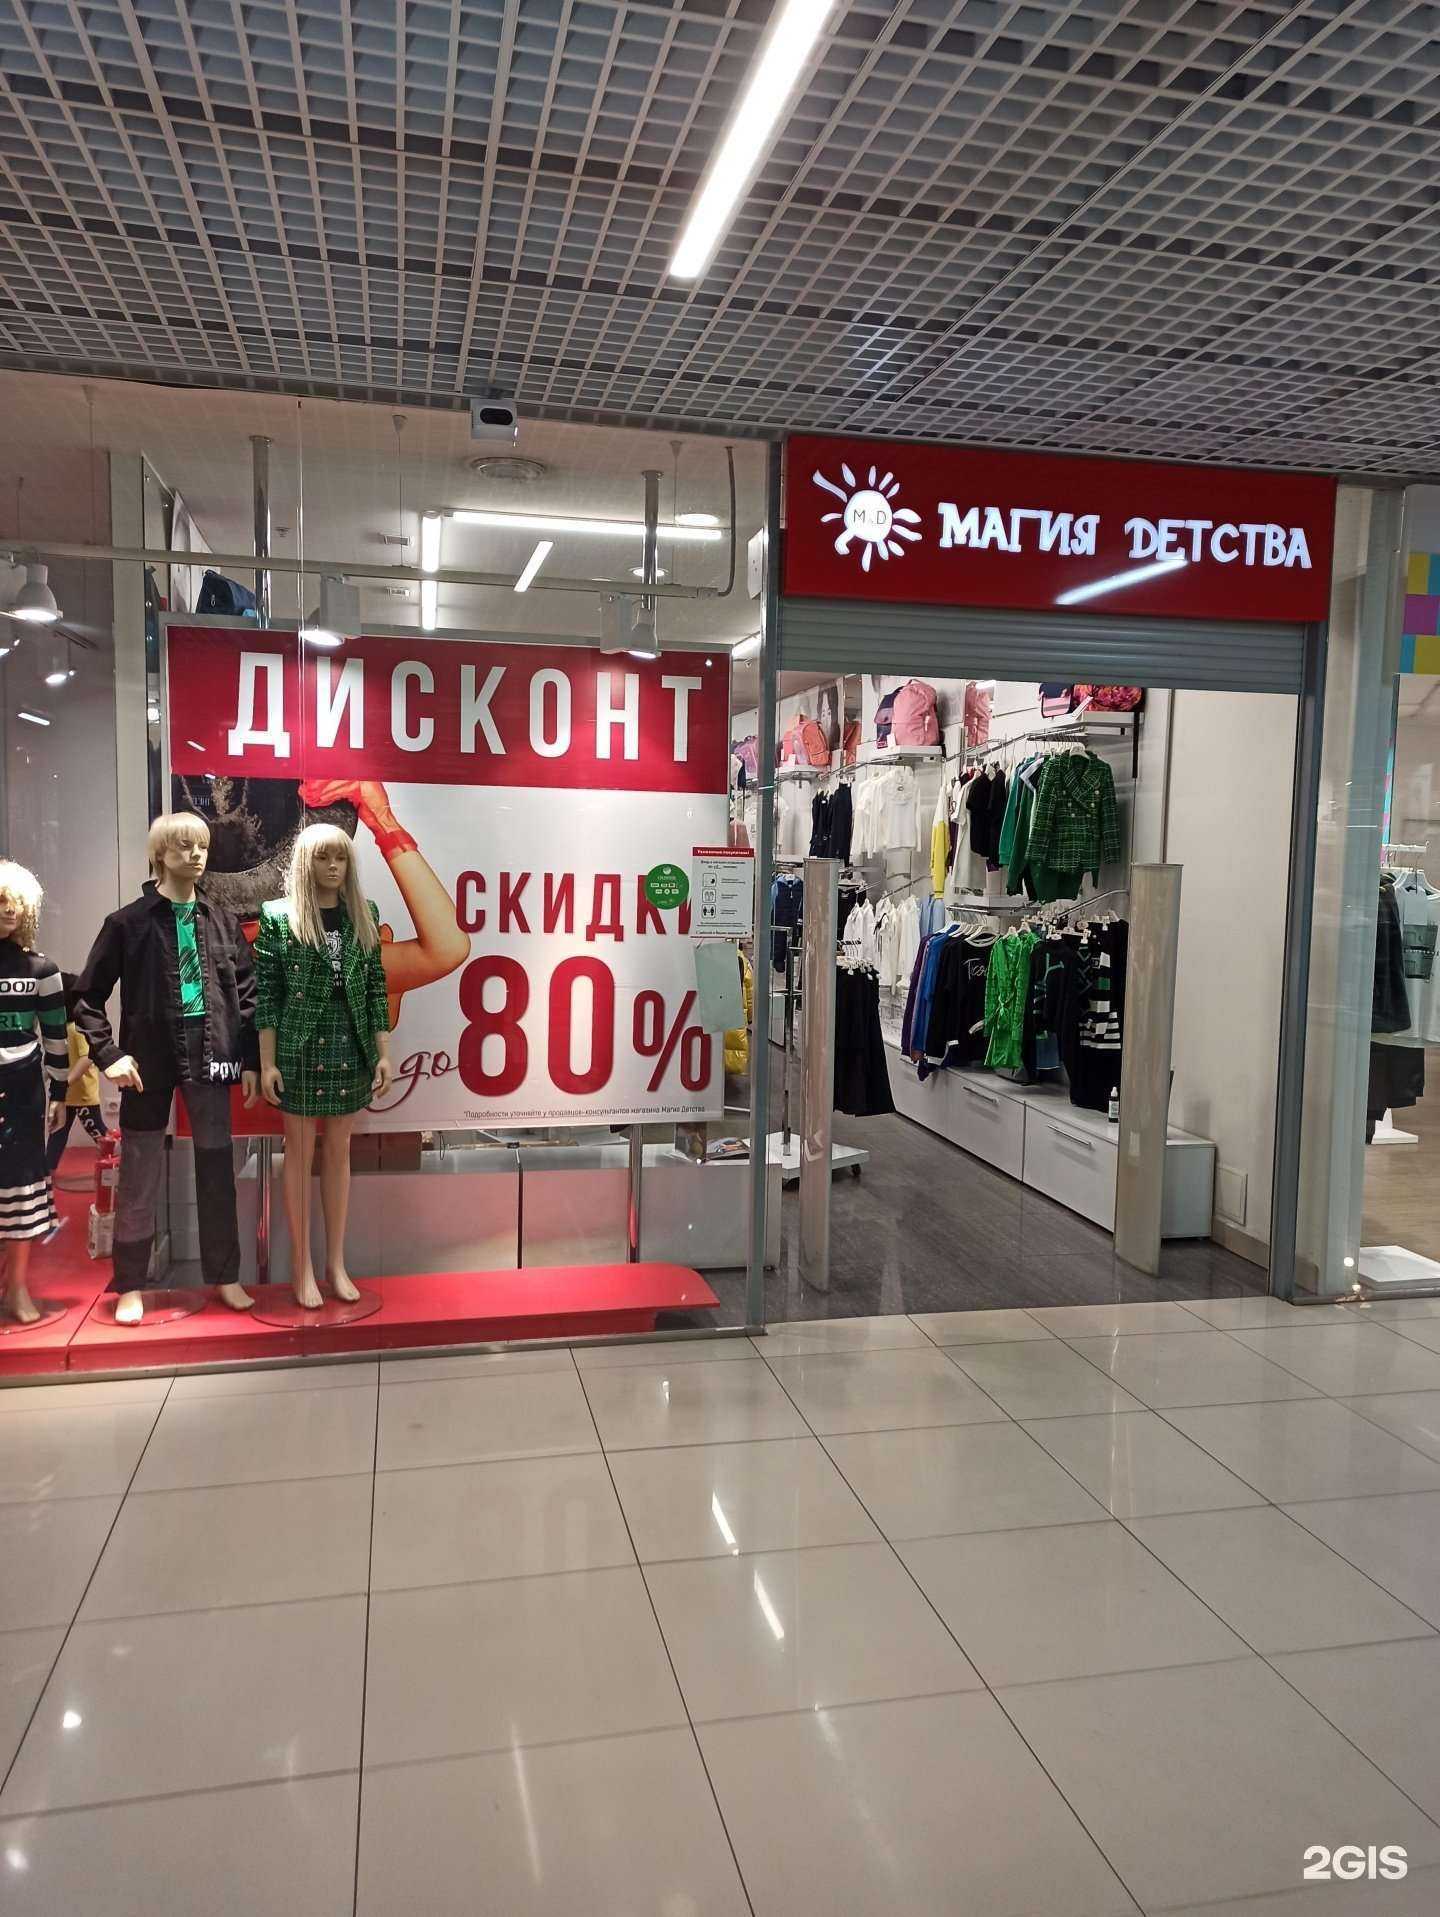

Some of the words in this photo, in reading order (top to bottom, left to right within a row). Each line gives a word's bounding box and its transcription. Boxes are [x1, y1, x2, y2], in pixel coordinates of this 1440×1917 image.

[938, 502, 1100, 556] МАГИЯ
[227, 651, 702, 762] ДИСКОНТ
[456, 870, 692, 942] СКИДК
[458, 955, 712, 1096] 80%
[631, 1107, 660, 1115] магазина
